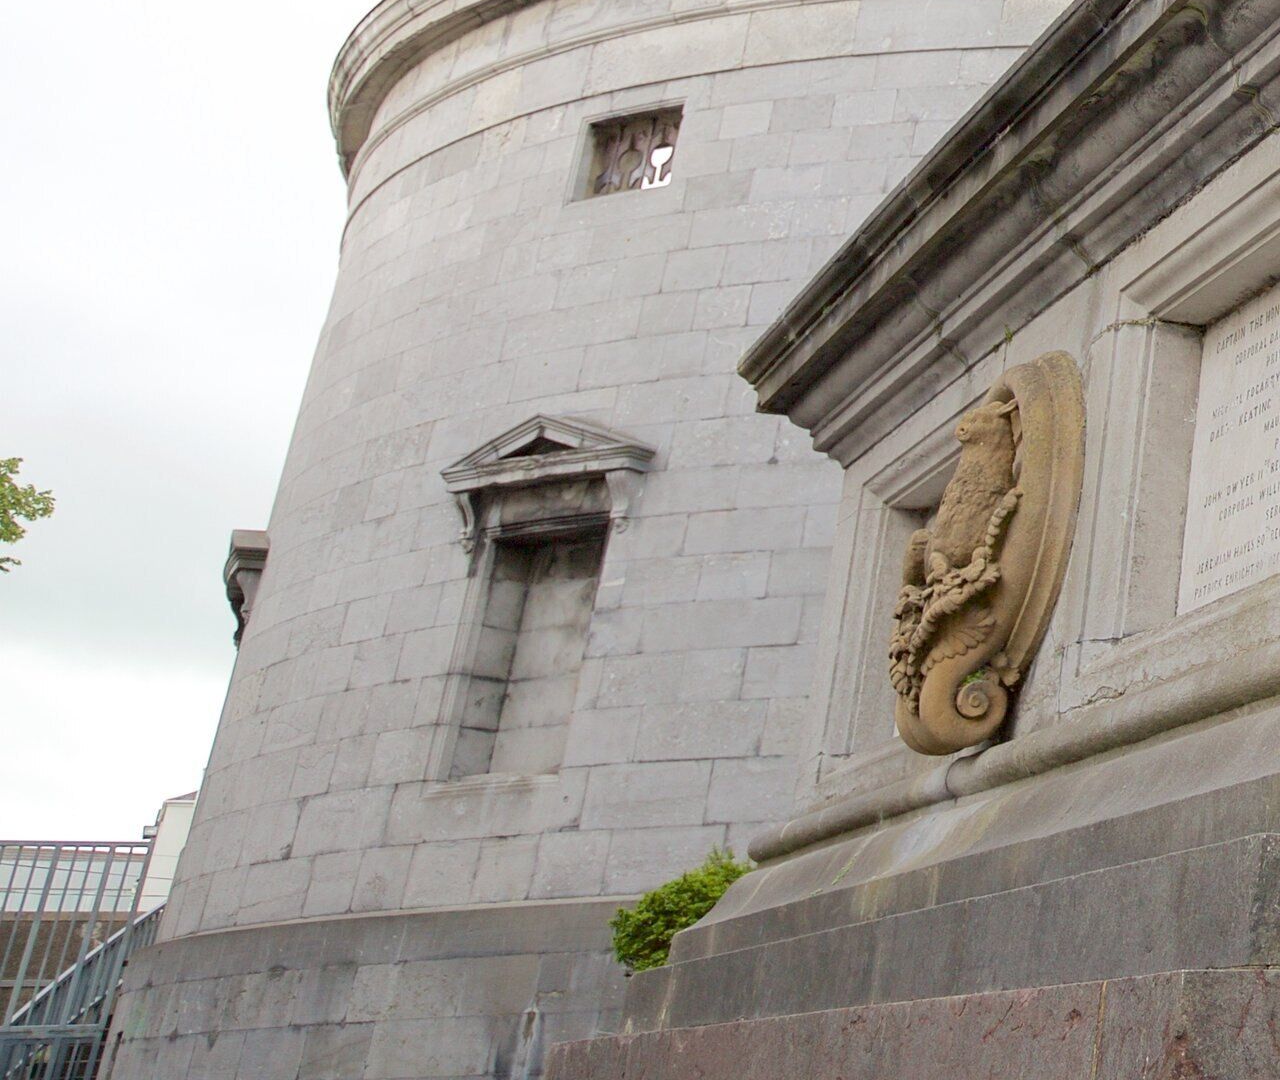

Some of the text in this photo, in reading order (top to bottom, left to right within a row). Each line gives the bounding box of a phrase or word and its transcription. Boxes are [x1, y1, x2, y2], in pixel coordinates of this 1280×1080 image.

[1250, 315, 1263, 332] THE
[1235, 338, 1267, 365] CORPORAL
[1204, 490, 1222, 508] JOHN
[1218, 495, 1254, 521] CORPORAL
